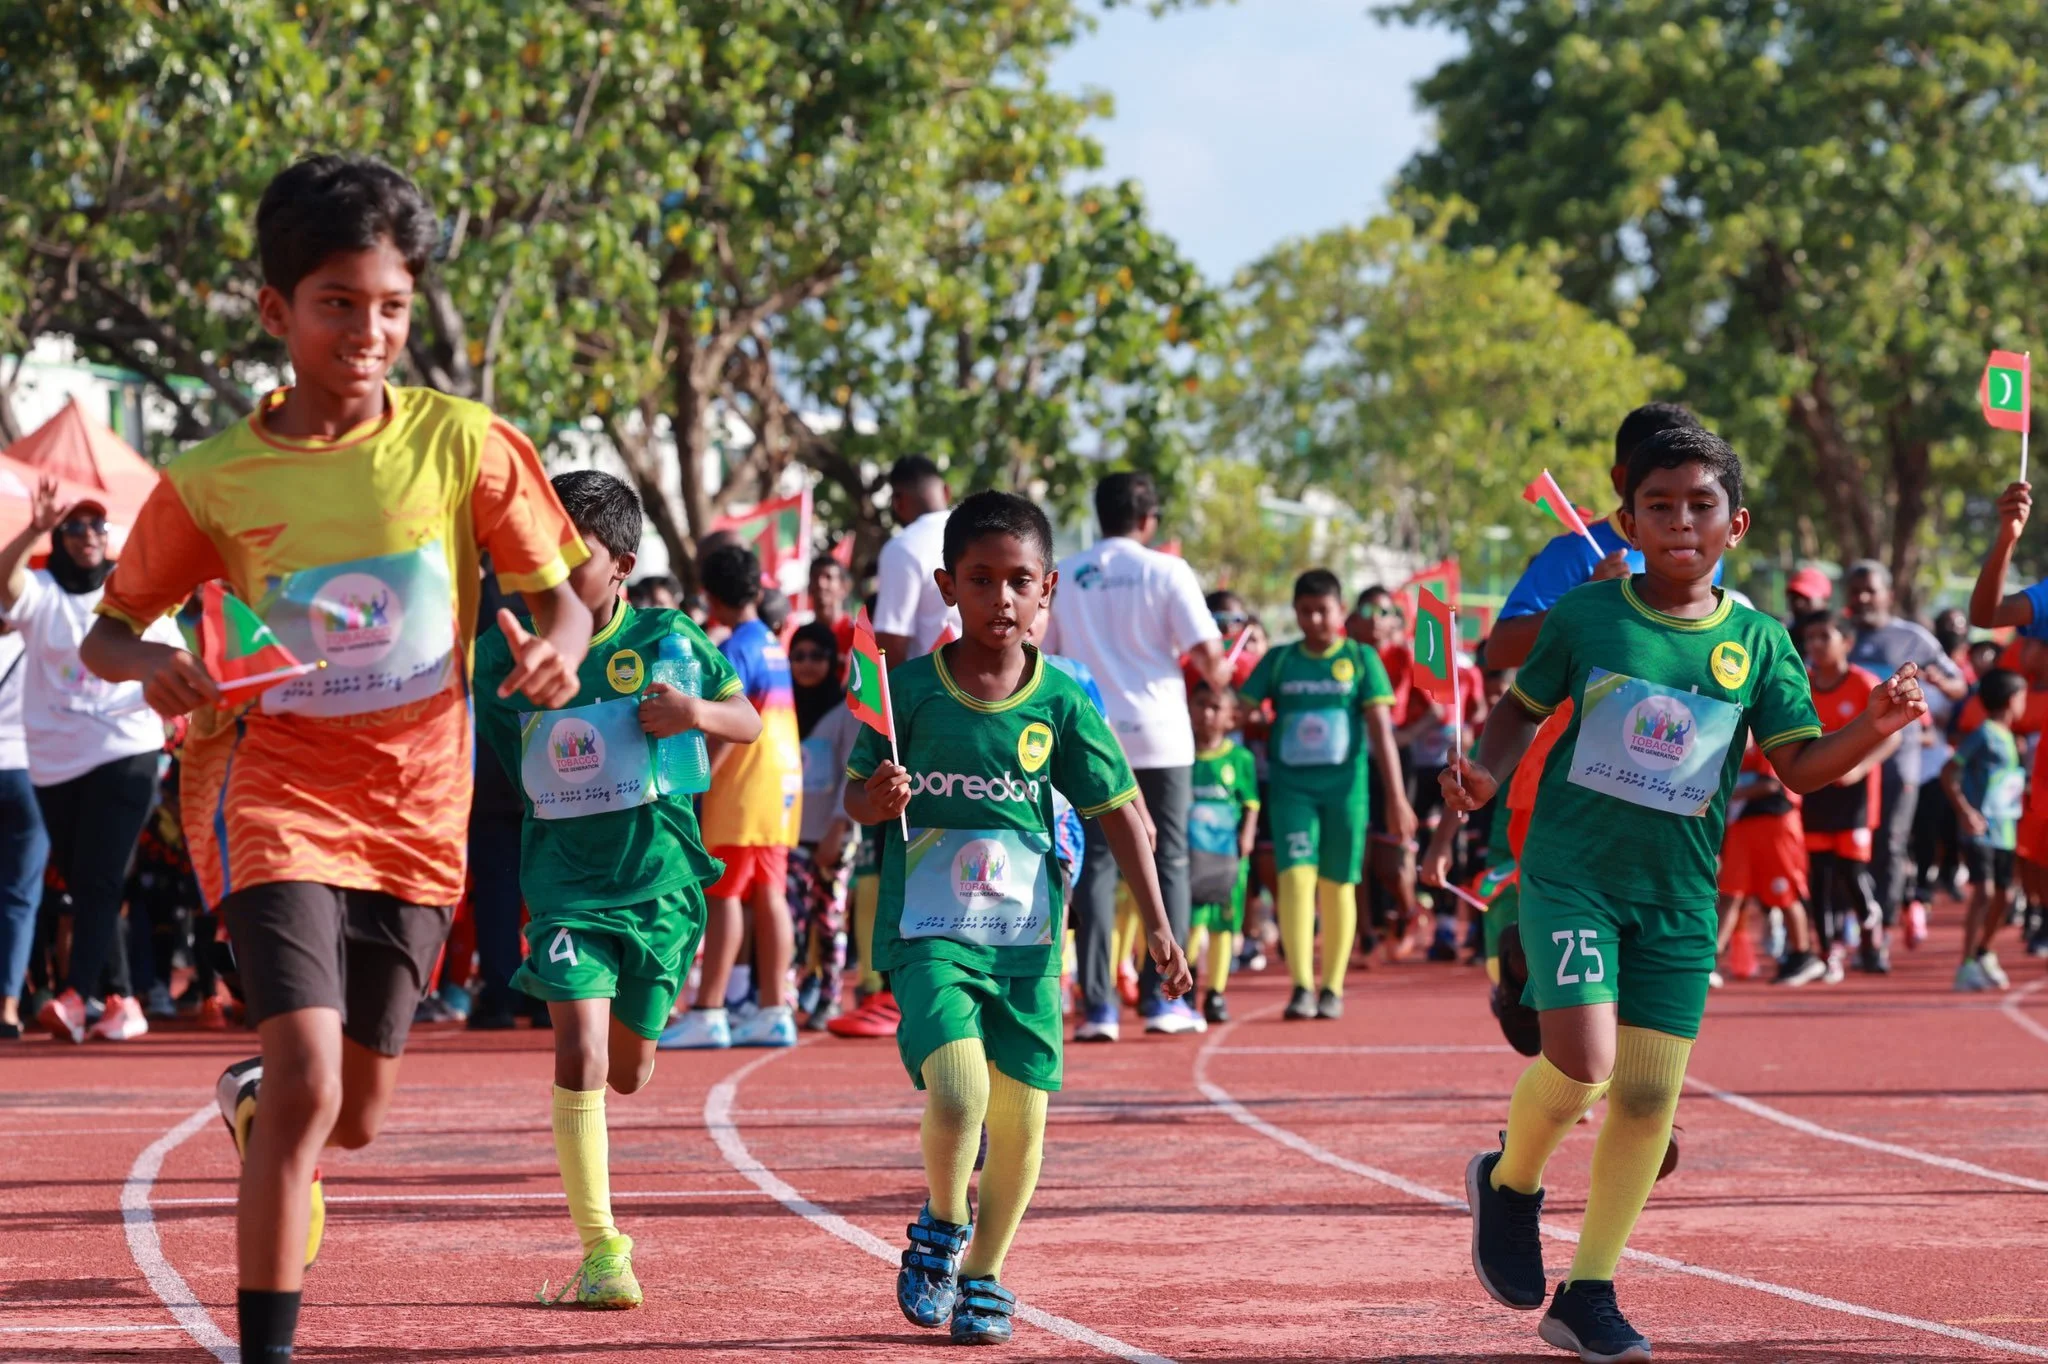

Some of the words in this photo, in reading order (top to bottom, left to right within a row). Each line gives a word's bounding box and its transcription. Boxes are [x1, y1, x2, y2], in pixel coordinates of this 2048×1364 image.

[1630, 744, 1645, 754] FREE
[1645, 748, 1680, 761] GENERATION
[1631, 735, 1683, 756] TOBACCO
[557, 755, 599, 768] TOBACCO
[960, 881, 1000, 891] TOBAC
[548, 927, 579, 967] 4
[1551, 929, 1604, 986] 25
